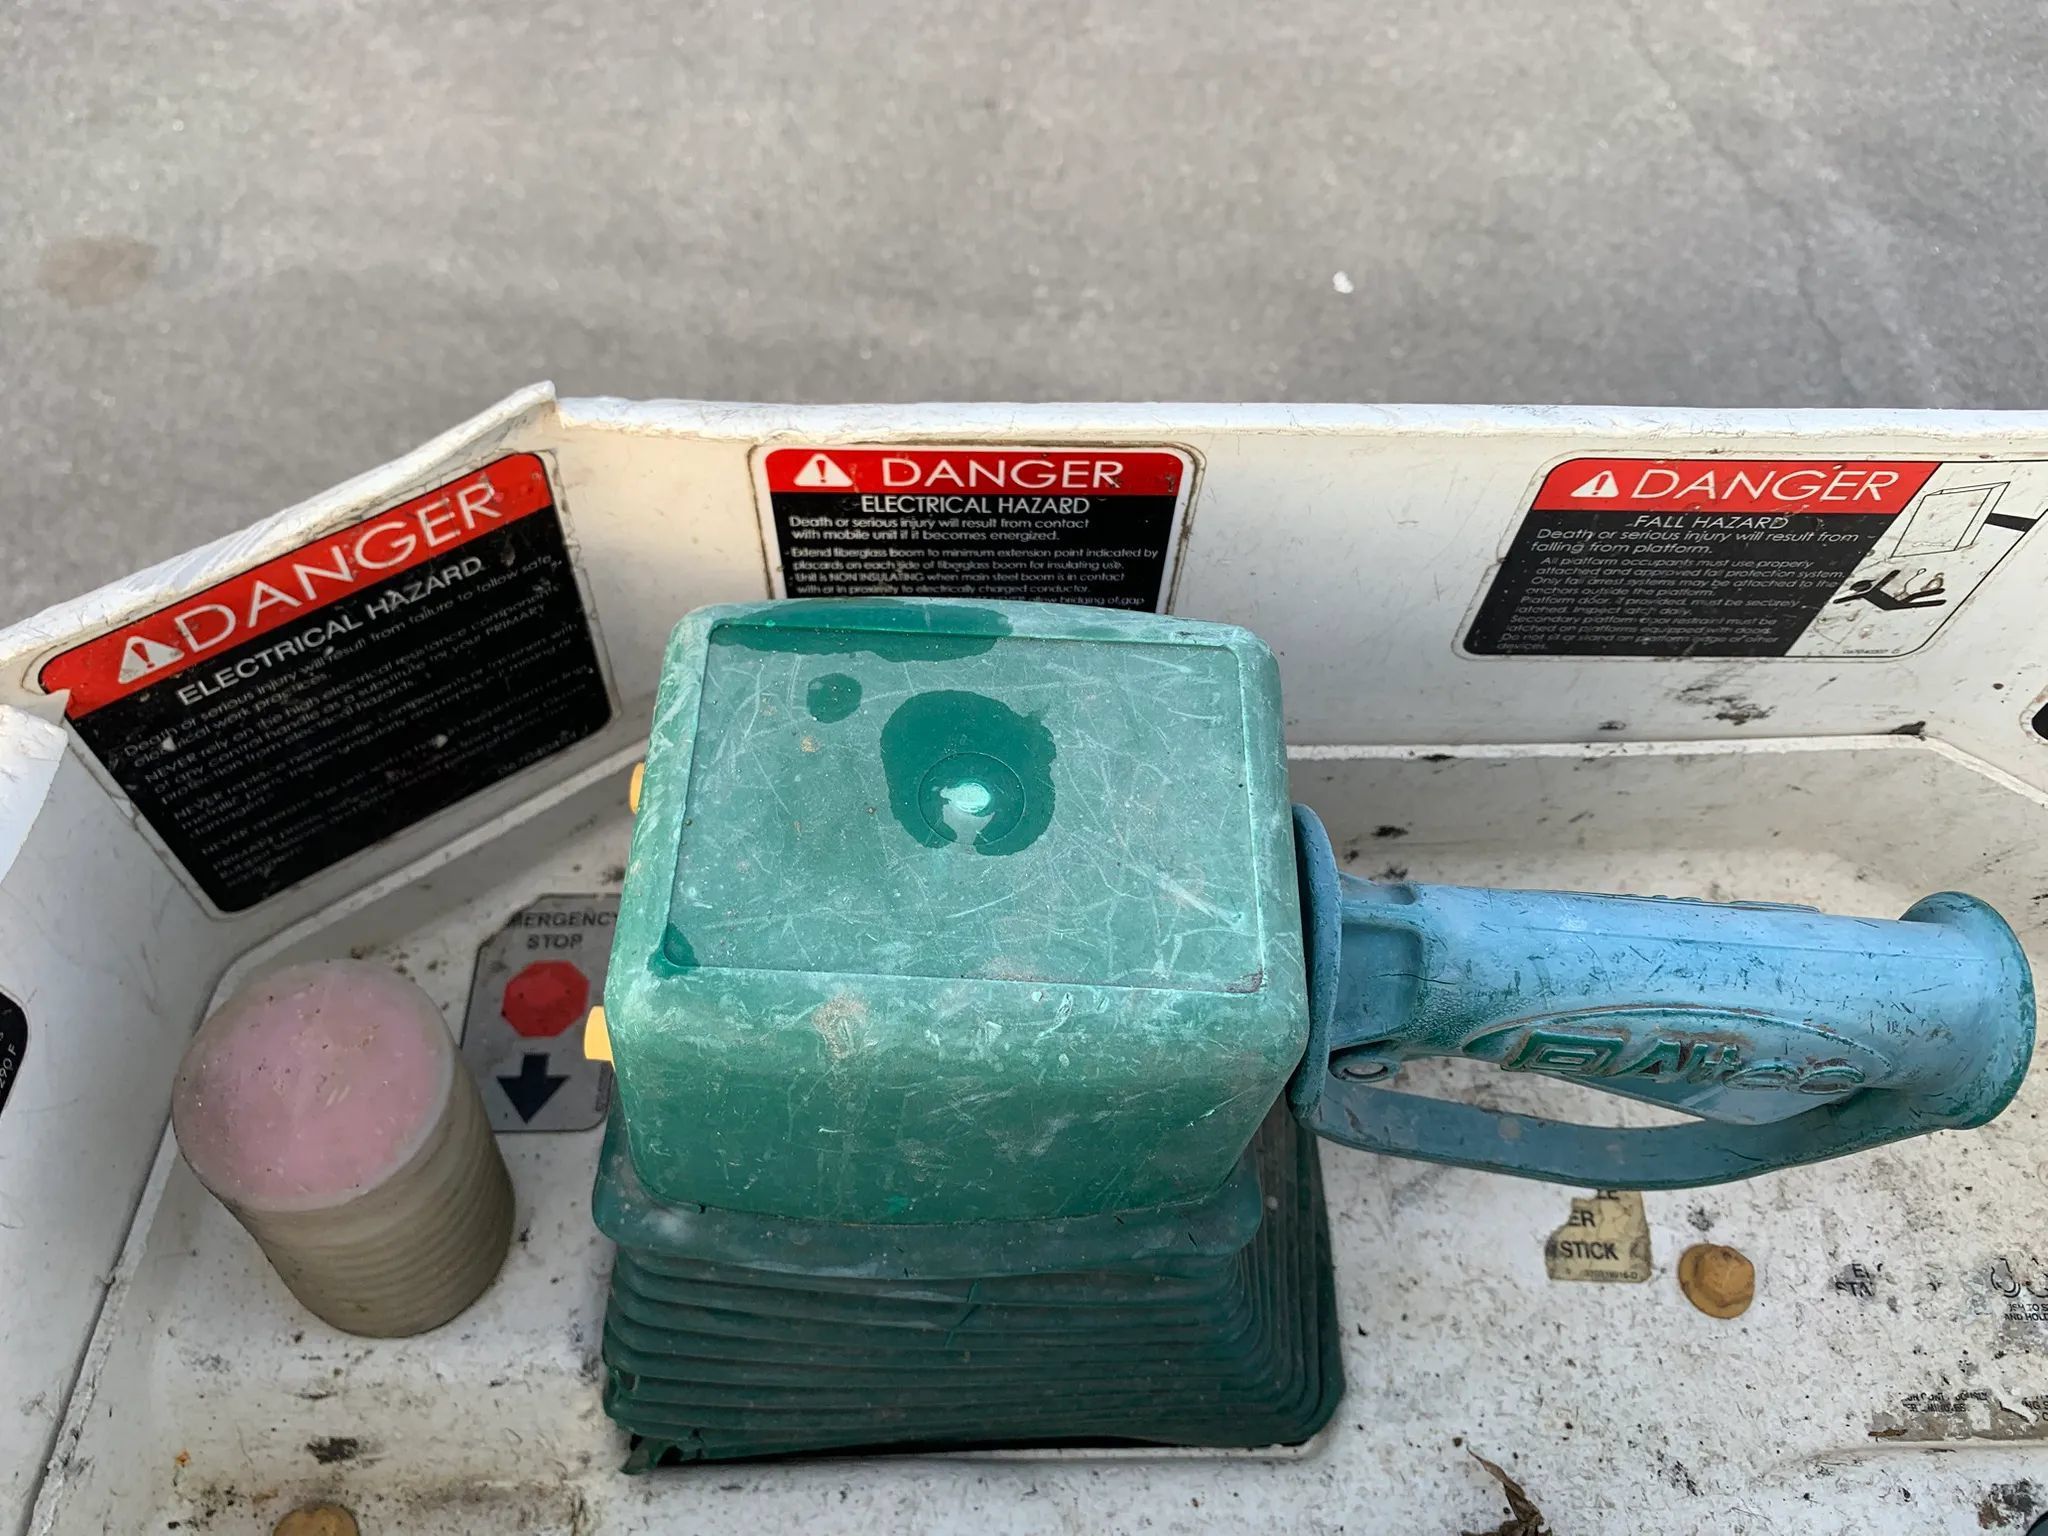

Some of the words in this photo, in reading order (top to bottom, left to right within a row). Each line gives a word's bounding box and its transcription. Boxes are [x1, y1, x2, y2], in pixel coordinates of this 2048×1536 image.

[881, 458, 1124, 489] DANGER
[1630, 469, 1900, 502] DANGER
[861, 495, 992, 514] ELECTRICAL
[998, 496, 1091, 515] HAZARD
[789, 515, 833, 528] Death
[835, 518, 849, 528] or
[852, 516, 897, 528] serious
[900, 516, 935, 531] injury
[938, 516, 960, 528] will
[962, 517, 997, 529] result
[1001, 517, 1032, 529] from
[1034, 518, 1090, 529] contact
[1633, 515, 1685, 528] FALL
[1692, 516, 1790, 530] HAZARD
[792, 530, 818, 540] with
[823, 530, 870, 541] mobile
[872, 530, 897, 540] unit
[900, 530, 908, 540] if
[911, 530, 920, 540] it
[922, 530, 987, 541] becomes
[990, 530, 1060, 542] energized.
[1536, 529, 1592, 541] Death
[1597, 531, 1618, 540] or
[1619, 530, 1681, 541] serious
[1683, 530, 1732, 544] injury
[1735, 531, 1764, 542] will
[1765, 531, 1814, 542] result
[1816, 532, 1859, 543] from
[888, 548, 925, 558] boom
[927, 548, 940, 558] to
[942, 549, 994, 558] minimum
[997, 549, 1051, 558] extension
[1054, 549, 1084, 560] point
[1086, 549, 1141, 558] indicated
[1144, 549, 1159, 560] by
[1531, 541, 1585, 555] falling
[1589, 541, 1629, 553] from
[1632, 541, 1713, 555] platform.
[174, 482, 503, 654] DANGER
[937, 561, 990, 572] fiberglass
[992, 561, 1027, 570] boom
[1029, 561, 1044, 570] for
[1047, 560, 1100, 572] insulating
[1560, 557, 1619, 567] platform
[1620, 557, 1691, 568] occupants
[1693, 558, 1729, 568] must
[1731, 560, 1754, 568] use
[1756, 559, 1814, 571] properly
[926, 573, 958, 582] when
[961, 572, 989, 582] main
[992, 572, 1018, 582] steel
[1021, 572, 1054, 582] boom
[1057, 573, 1065, 582] is
[1080, 573, 1125, 582] contact
[1536, 566, 1599, 577] attached
[1602, 567, 1632, 576] and
[1633, 567, 1701, 579] approved
[1724, 569, 1796, 580] protection
[1797, 570, 1846, 580] system.
[1531, 576, 1560, 587] Only
[1587, 577, 1623, 586] arrest
[1625, 577, 1676, 588] systems
[1678, 579, 1709, 589] may
[1711, 578, 1730, 587] be
[1733, 579, 1797, 588] attached
[1798, 579, 1813, 588] to
[1815, 579, 1839, 588] the
[978, 585, 1027, 596] charged
[175, 613, 364, 706] ELECTRICAL
[366, 555, 484, 621] HAZARD
[122, 724, 180, 758] Death
[178, 715, 199, 732] or
[198, 689, 256, 723] serious
[255, 668, 300, 698] injury
[296, 656, 327, 678] will
[369, 618, 407, 644] from
[407, 595, 455, 627] failure
[456, 587, 474, 604] to
[475, 565, 520, 596] follow
[507, 911, 618, 928] MERGENC
[527, 933, 583, 949] STOP
[1560, 1240, 1619, 1260] STICK
